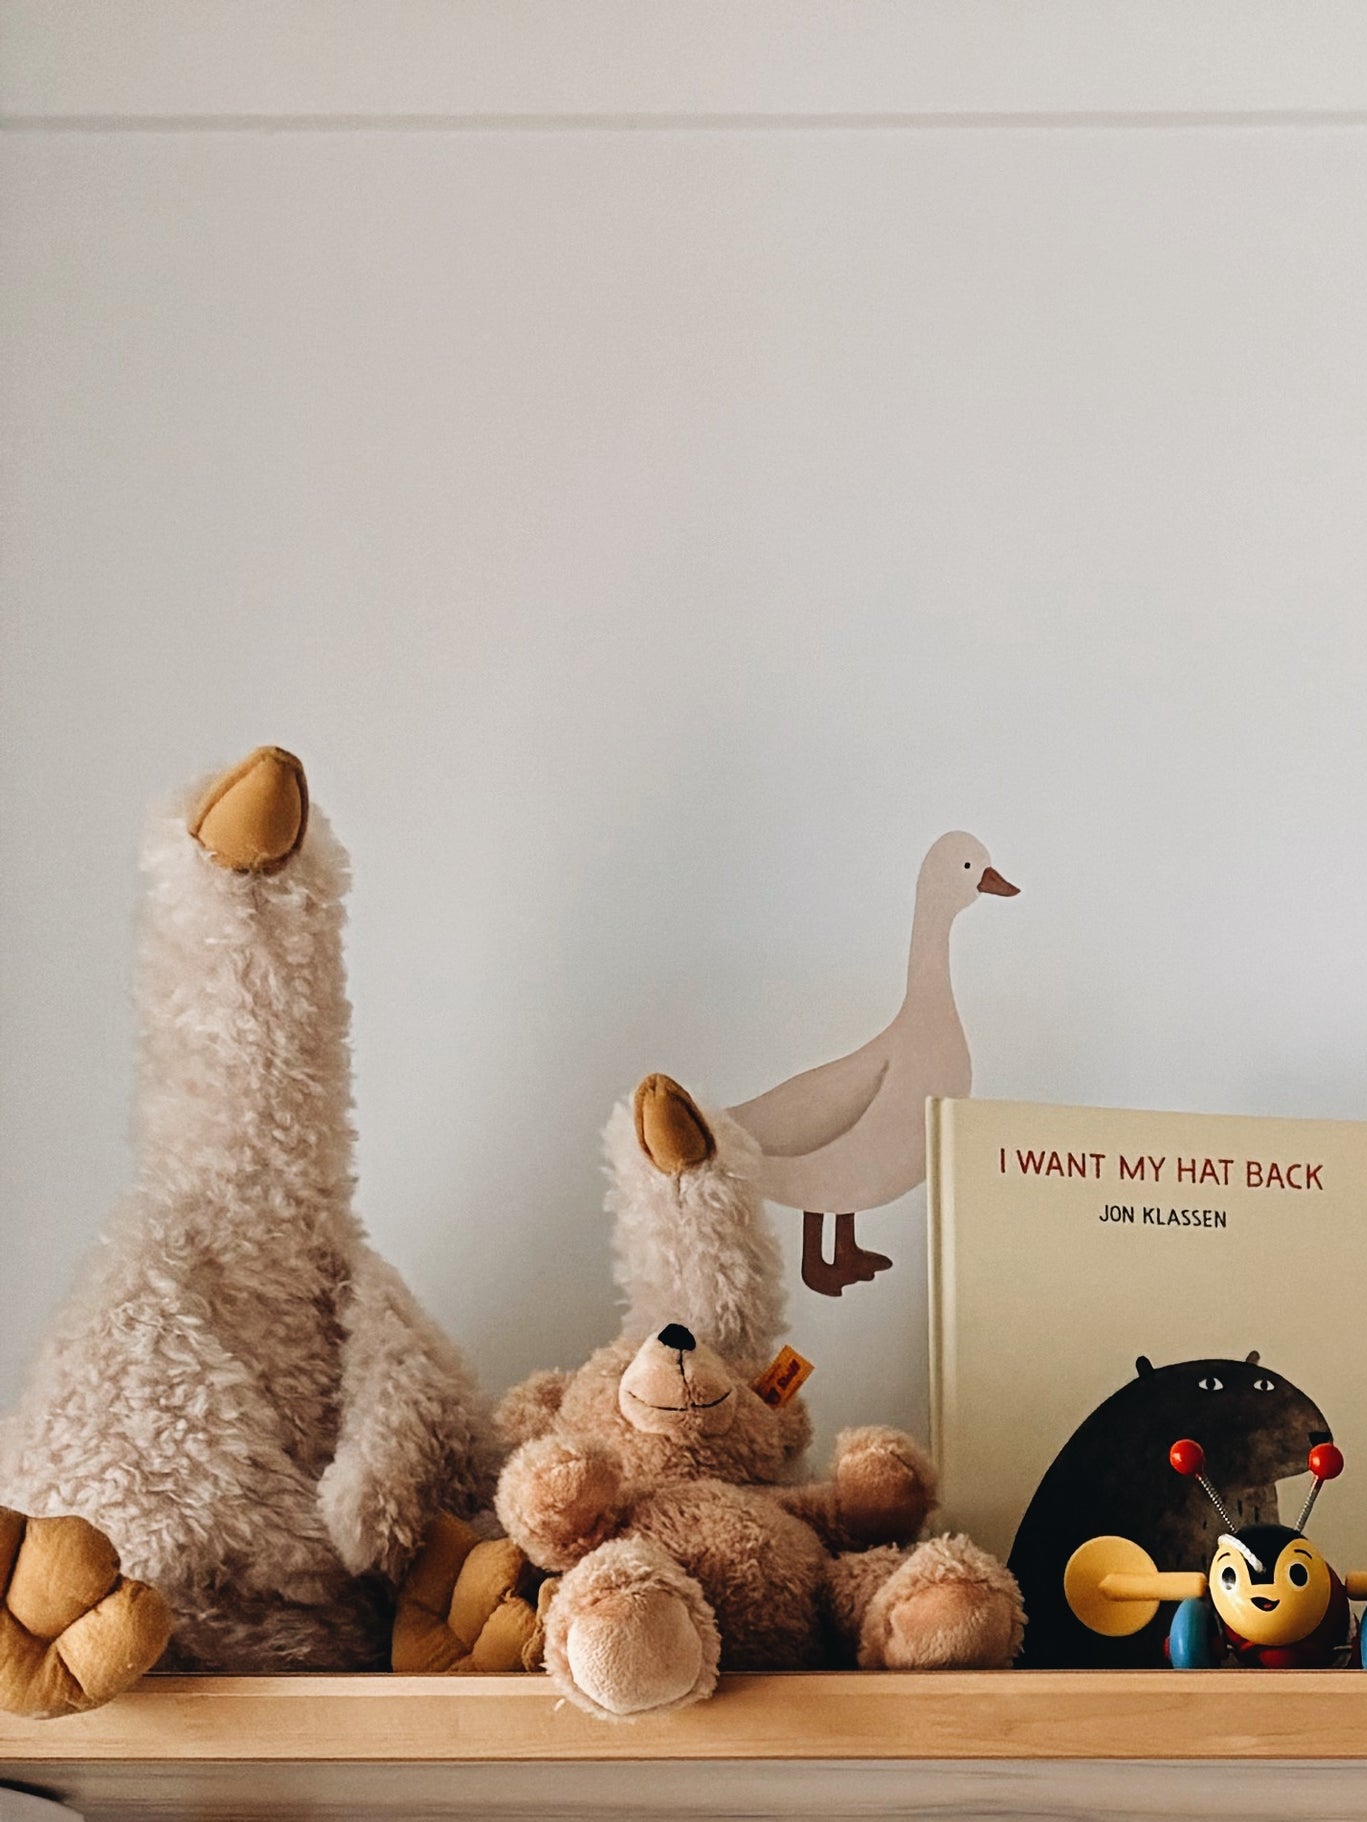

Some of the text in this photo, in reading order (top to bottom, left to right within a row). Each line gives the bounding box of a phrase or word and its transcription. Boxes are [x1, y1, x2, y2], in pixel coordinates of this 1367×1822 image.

[999, 1147, 1325, 1191] I WANT MY HAT BACK
[1098, 1203, 1228, 1229] JON KLASSEN
